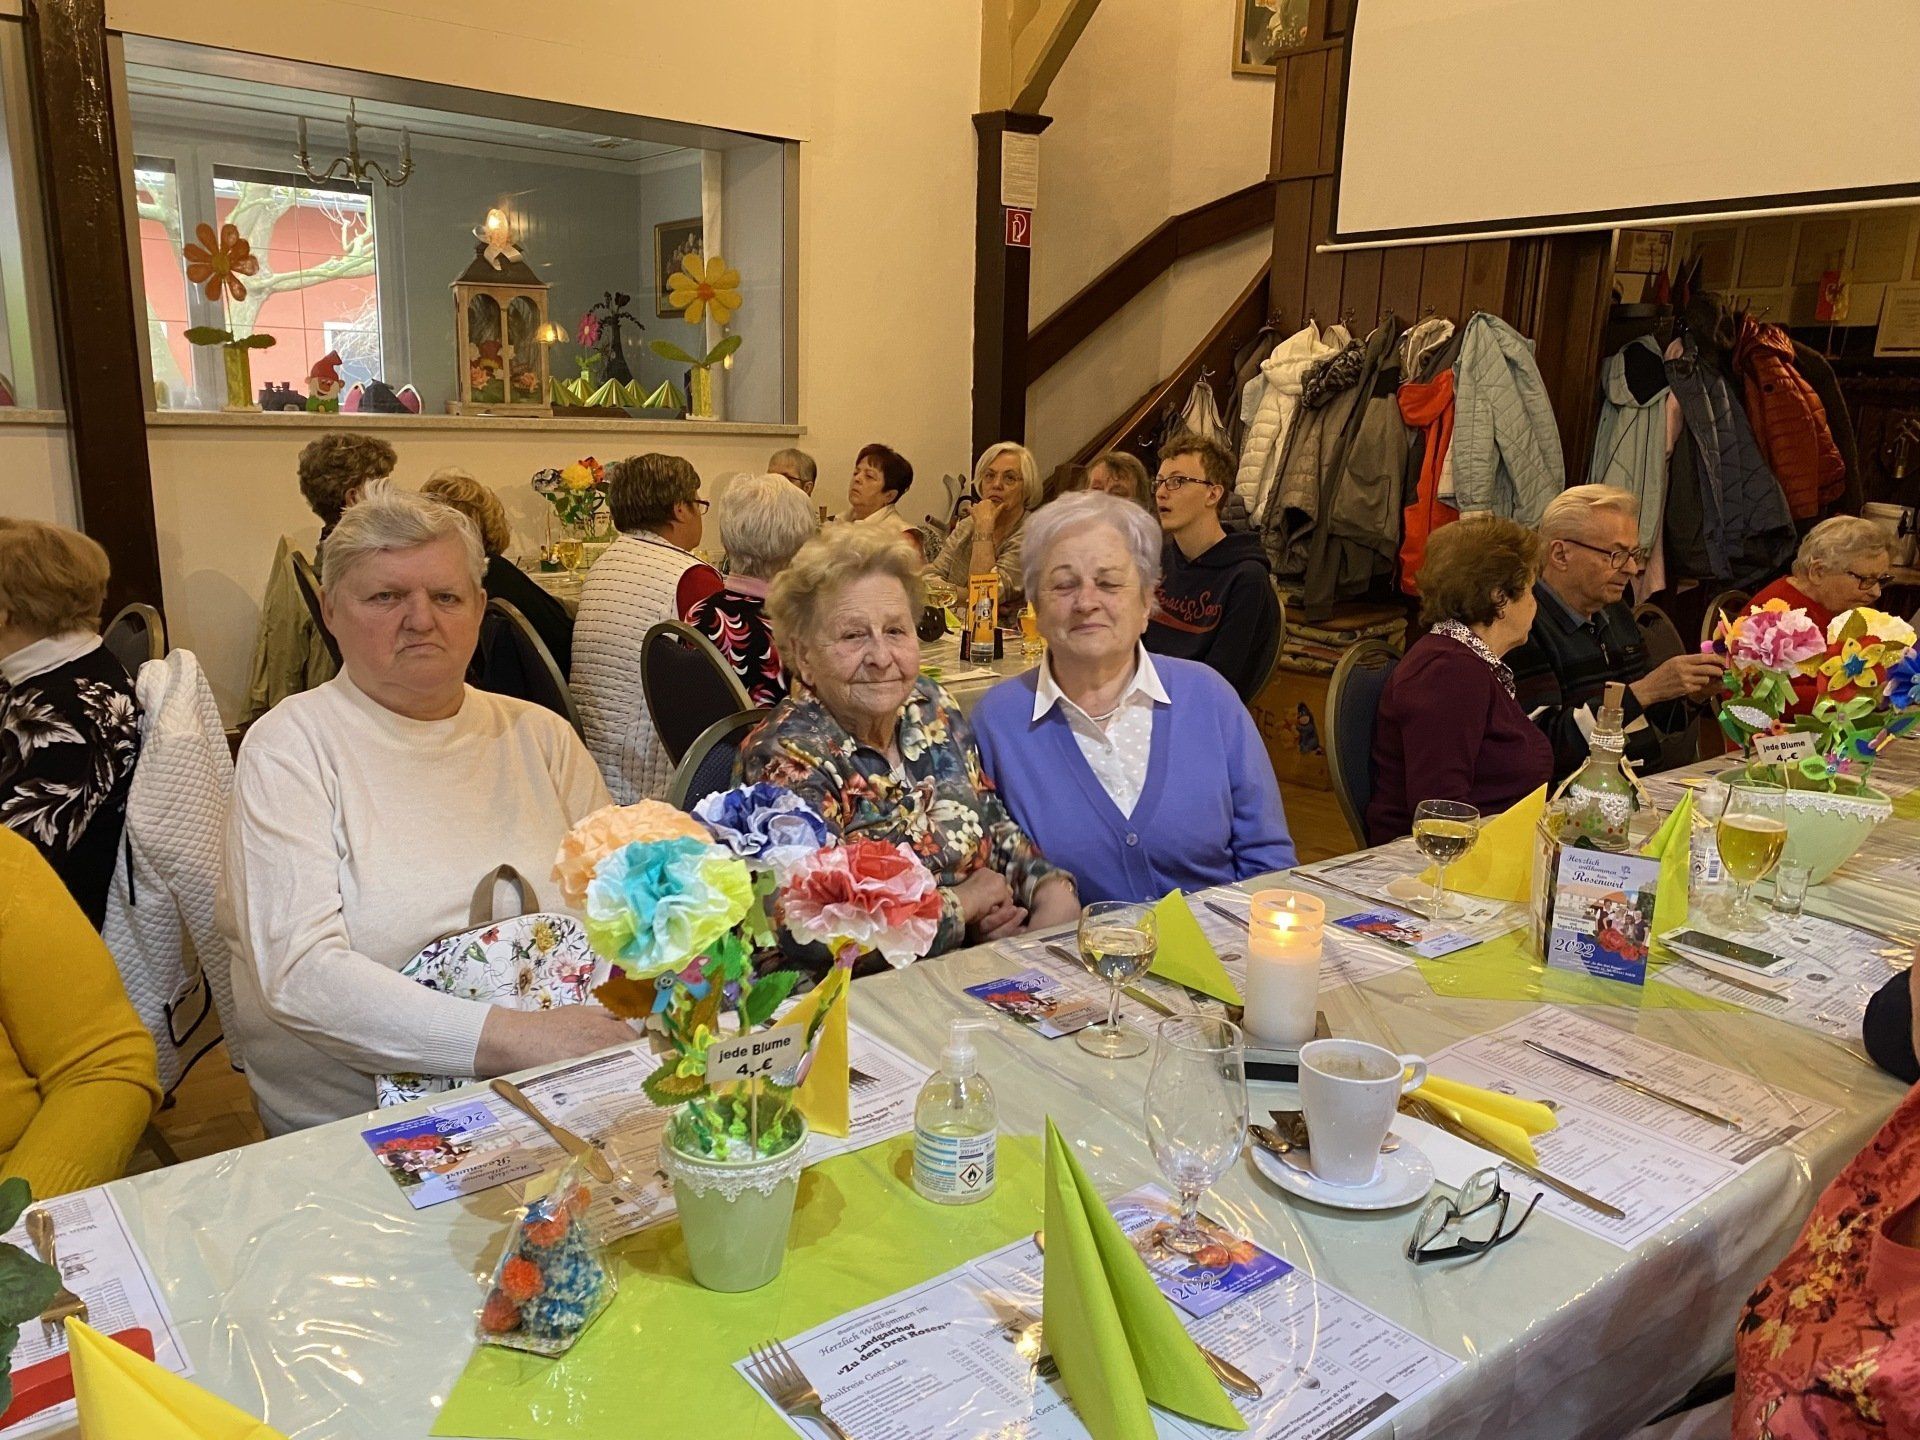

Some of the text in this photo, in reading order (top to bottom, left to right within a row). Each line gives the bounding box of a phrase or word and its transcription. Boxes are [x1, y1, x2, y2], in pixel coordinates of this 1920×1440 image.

[1763, 740, 1806, 753] jede Blume
[1567, 854, 1600, 867] Herzlich
[1572, 870, 1625, 889] Rosenwirt
[1554, 938, 1596, 958] 2022
[718, 1037, 791, 1064] jede Blume
[736, 1057, 773, 1078] 4,-€
[436, 1111, 486, 1133] 2022
[819, 1332, 860, 1357] Herzlich
[860, 1310, 916, 1337] Willkommen
[854, 1322, 915, 1353] Landgasthof
[860, 1346, 882, 1361] den
[880, 1334, 908, 1350] Drei
